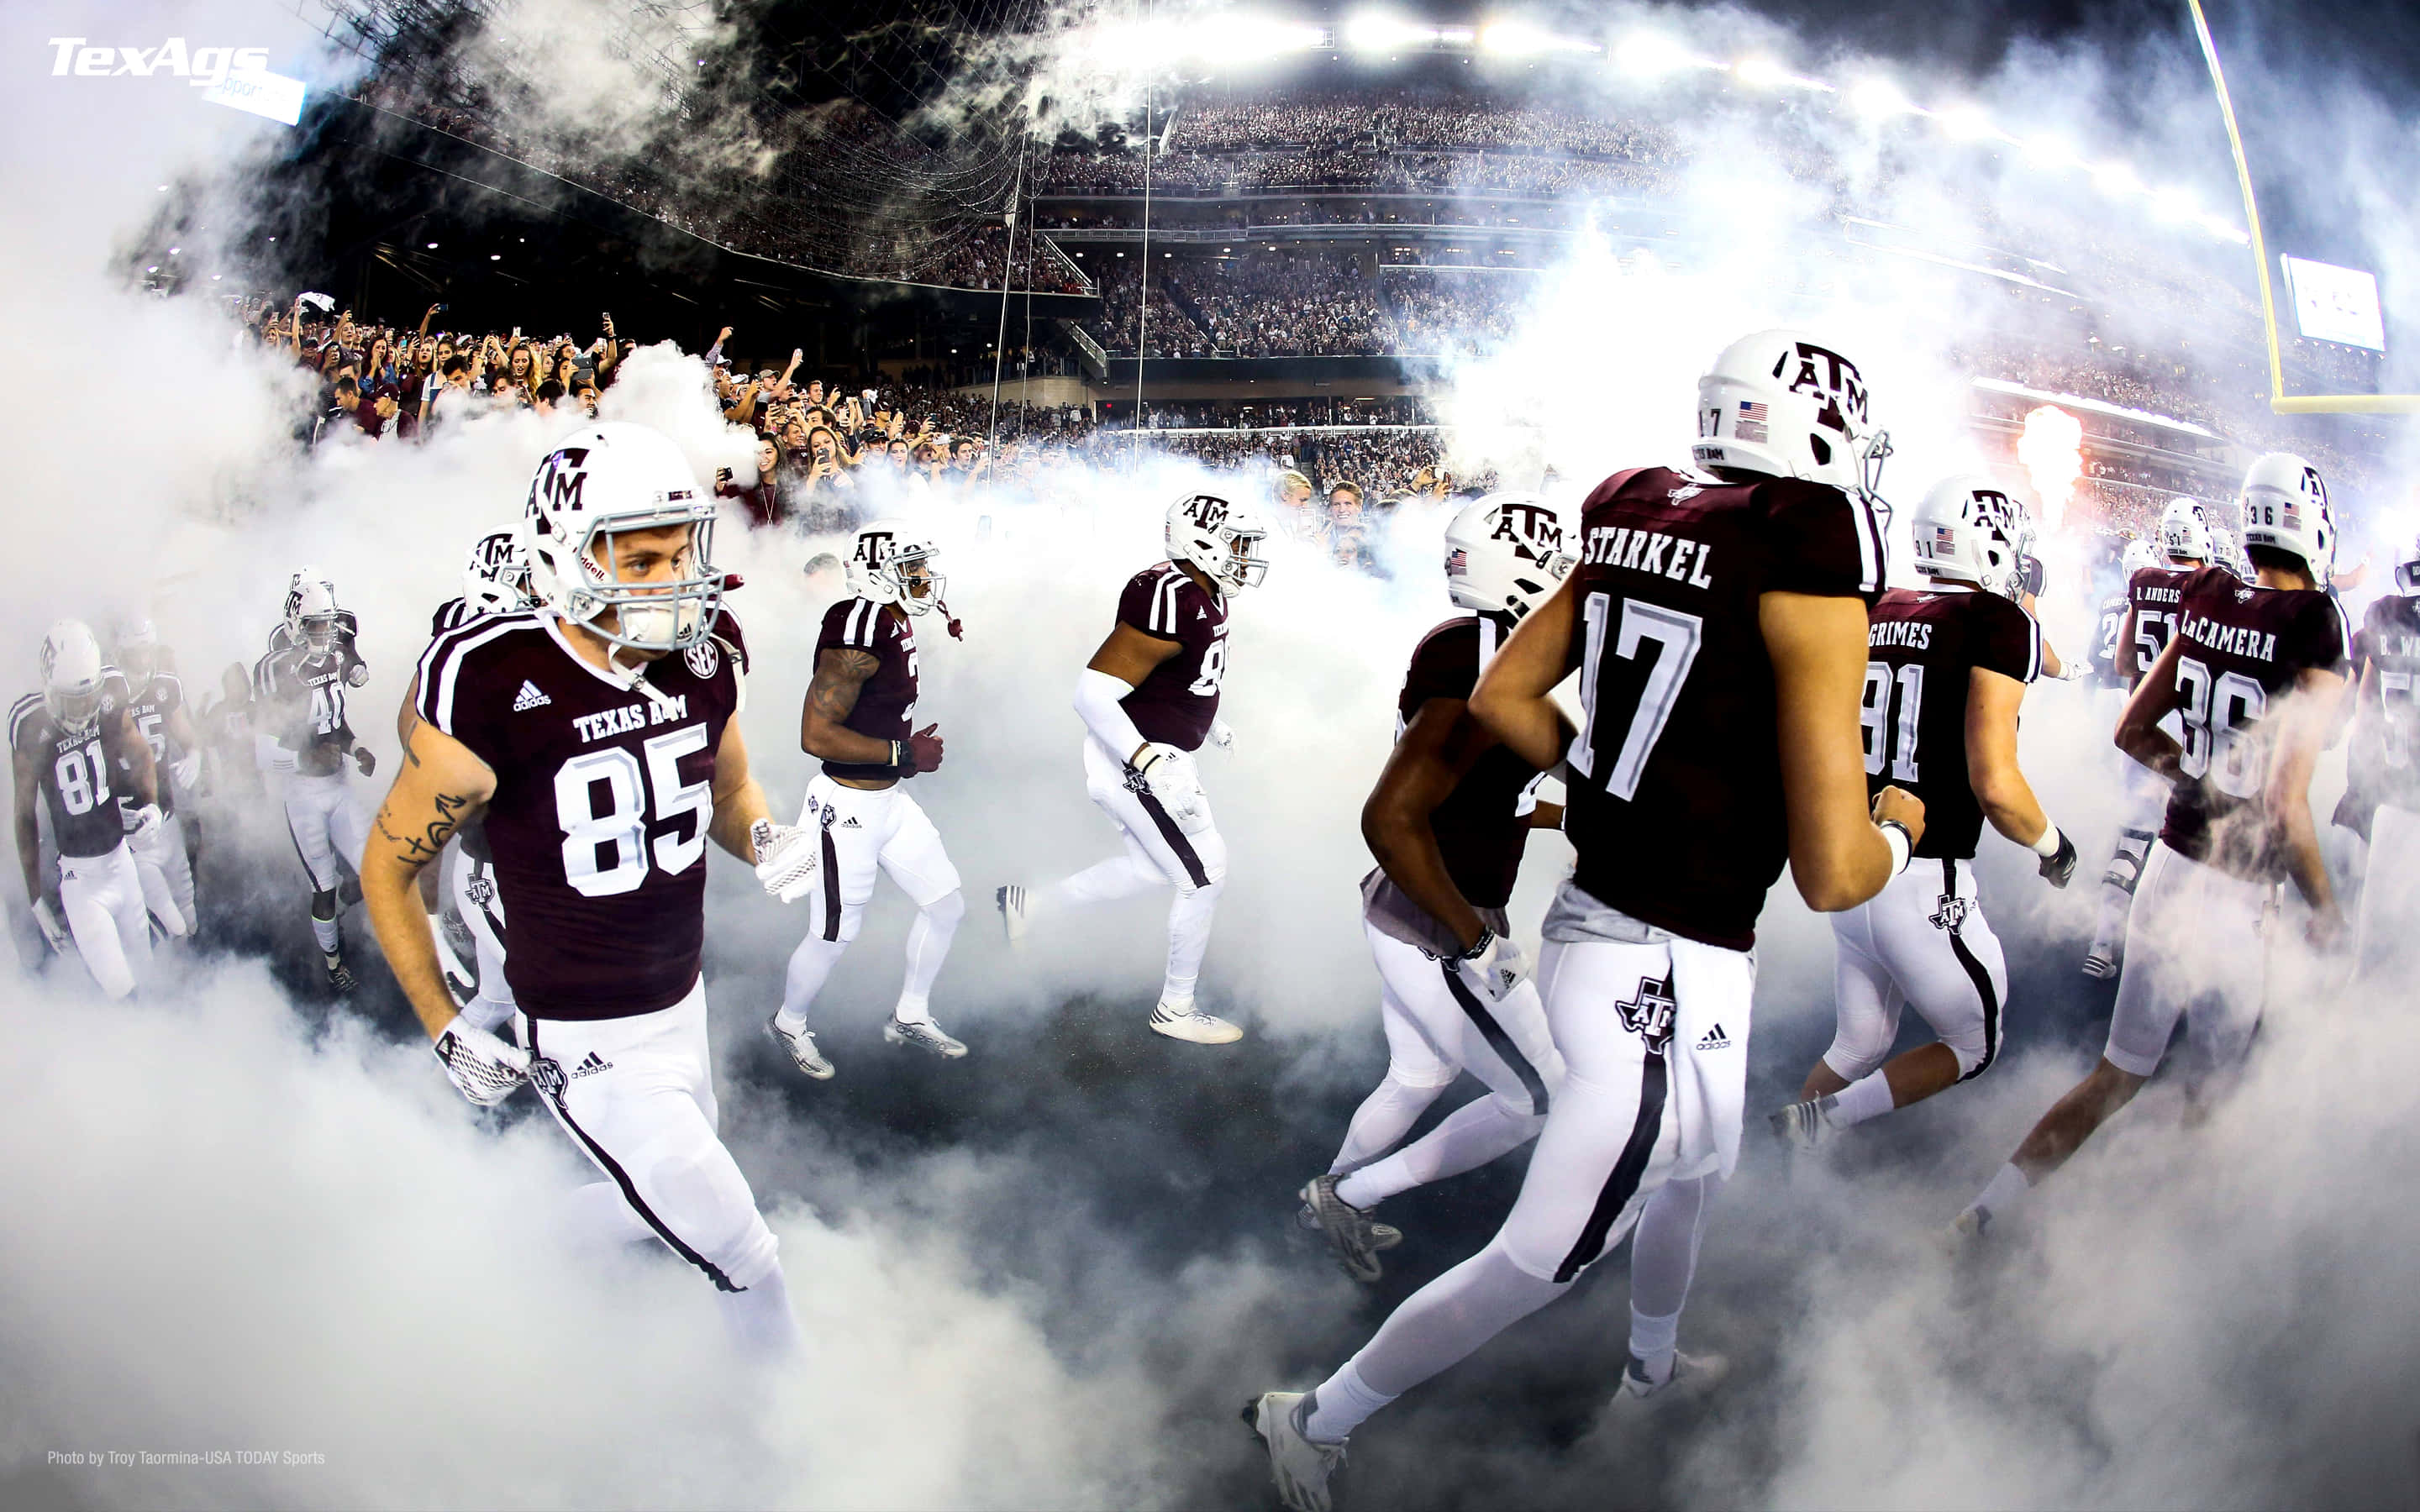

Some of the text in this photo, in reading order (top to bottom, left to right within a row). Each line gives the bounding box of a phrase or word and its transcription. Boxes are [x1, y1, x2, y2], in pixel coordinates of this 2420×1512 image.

[1699, 408, 1721, 437] 17
[2251, 506, 2273, 525] 36
[1585, 527, 1712, 590] STARKEL
[687, 641, 715, 674] SEC
[1869, 621, 1932, 650] GRIMES
[2135, 610, 2179, 673] 51
[308, 682, 345, 735] 40
[513, 695, 551, 711] adidas
[1566, 591, 1703, 802] 17
[573, 704, 645, 743] TEXAS
[1860, 661, 1924, 783] 91
[2175, 655, 2266, 799] 36
[55, 739, 110, 816] 81
[554, 722, 713, 897] 85
[1696, 1040, 1731, 1050] adidas
[571, 1062, 613, 1079] adidas
